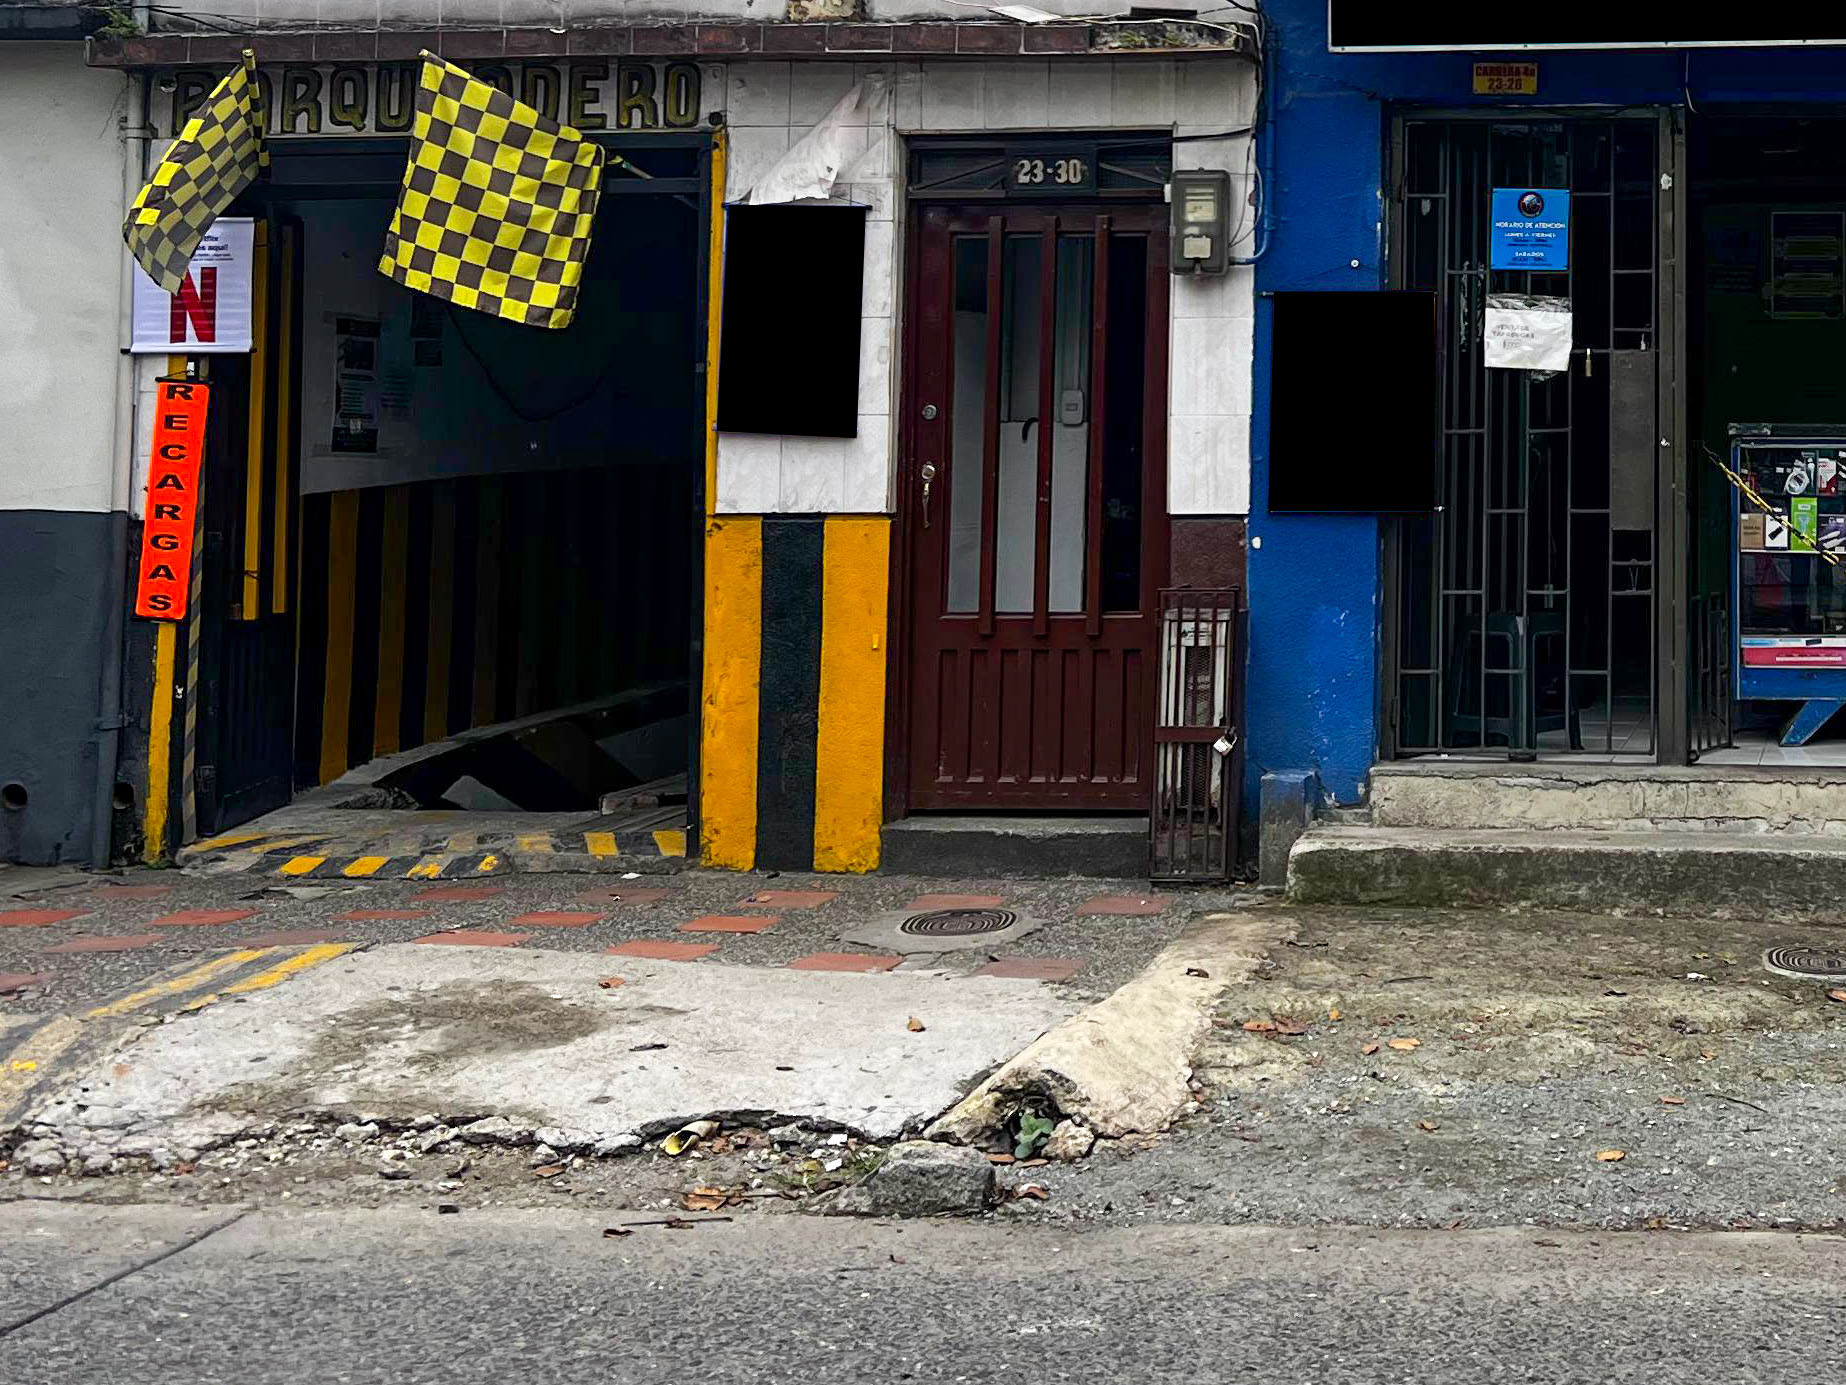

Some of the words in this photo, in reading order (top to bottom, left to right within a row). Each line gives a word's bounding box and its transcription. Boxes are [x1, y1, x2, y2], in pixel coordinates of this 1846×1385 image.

[174, 61, 702, 134] PRQUDERO
[1017, 159, 1082, 184] 23-30
[170, 266, 218, 344] N
[147, 384, 194, 611] RECARGAS
